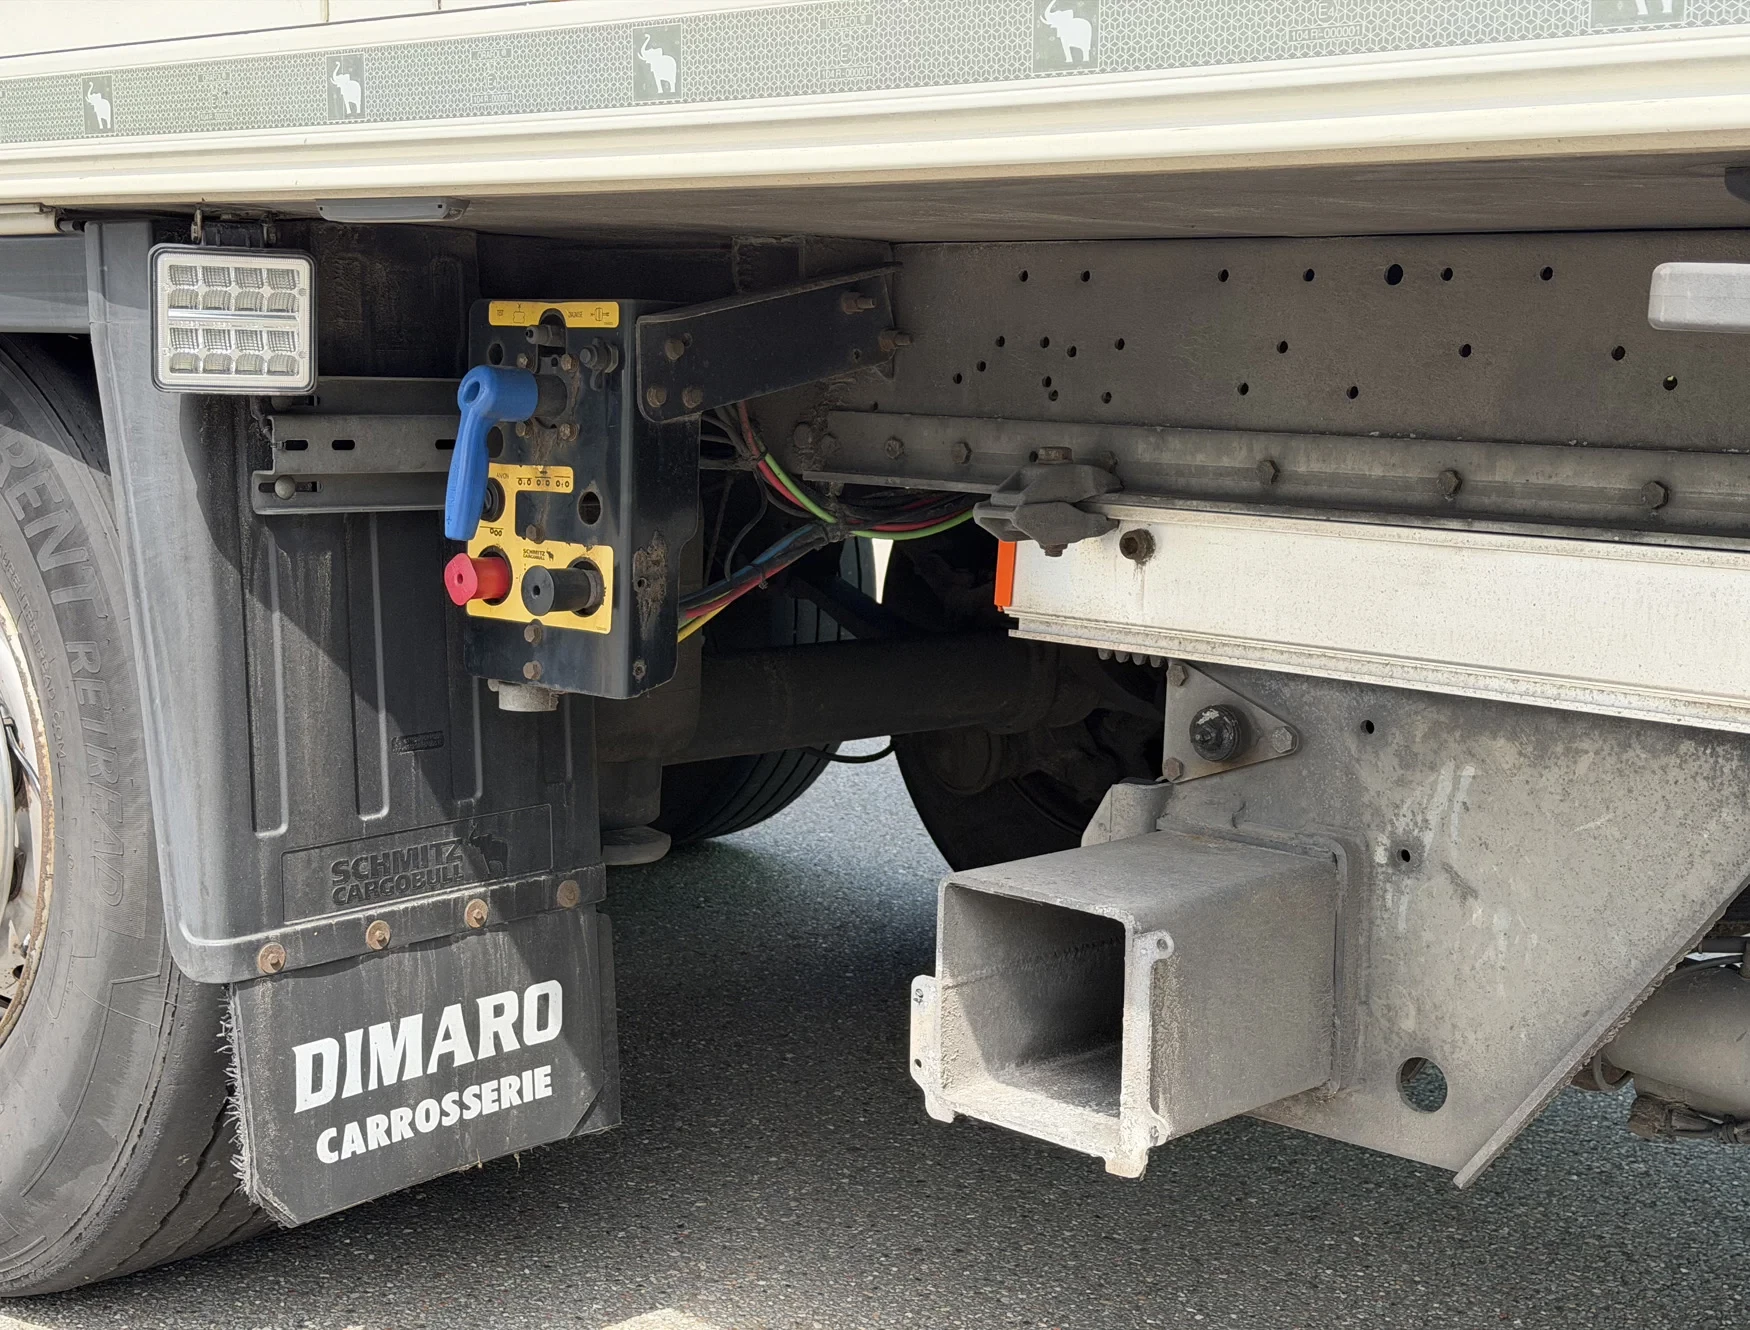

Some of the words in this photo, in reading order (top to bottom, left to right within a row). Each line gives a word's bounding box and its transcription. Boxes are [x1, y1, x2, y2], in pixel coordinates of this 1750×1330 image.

[65, 640, 124, 907] RETREAD
[331, 837, 464, 886] SCHMITZ
[332, 862, 464, 906] CARGOBULL
[292, 979, 563, 1114] DIMARO
[316, 1064, 553, 1164] CARROSSERIE
